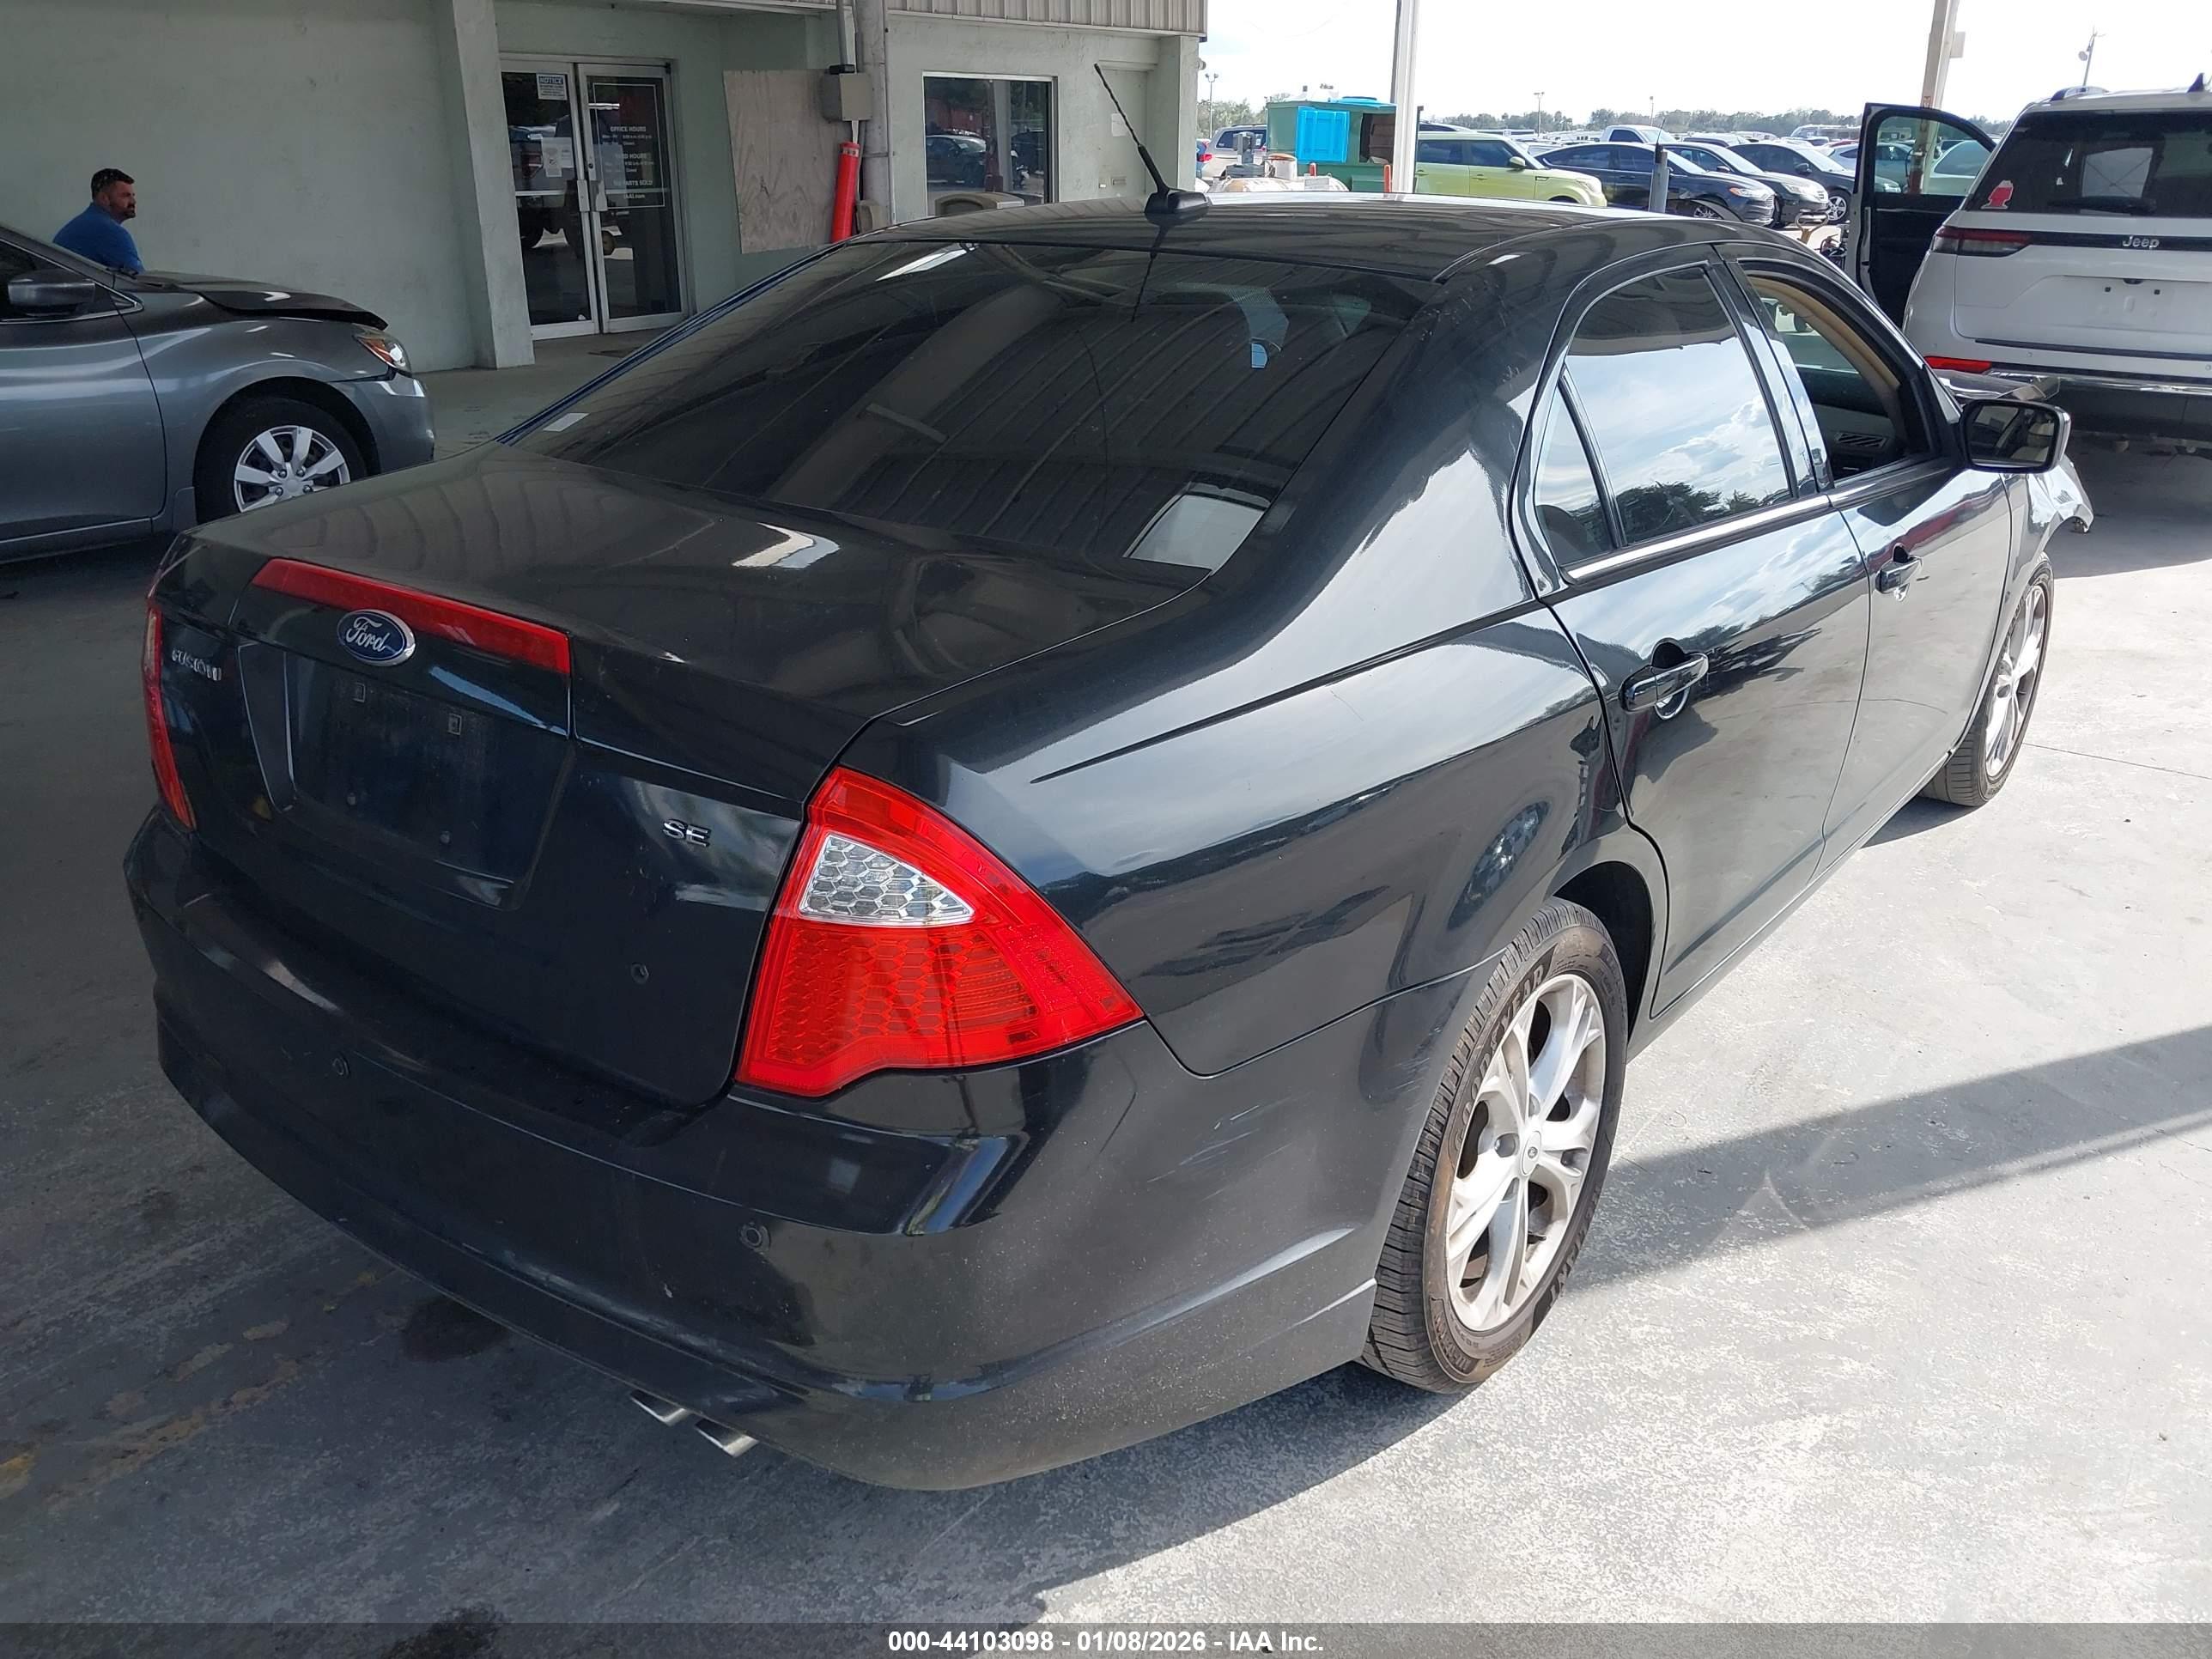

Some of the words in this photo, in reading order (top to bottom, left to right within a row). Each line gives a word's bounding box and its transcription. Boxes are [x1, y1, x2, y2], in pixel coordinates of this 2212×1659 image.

[2123, 235, 2160, 250] Jeep
[345, 616, 397, 653] Ford
[662, 818, 710, 848] SE
